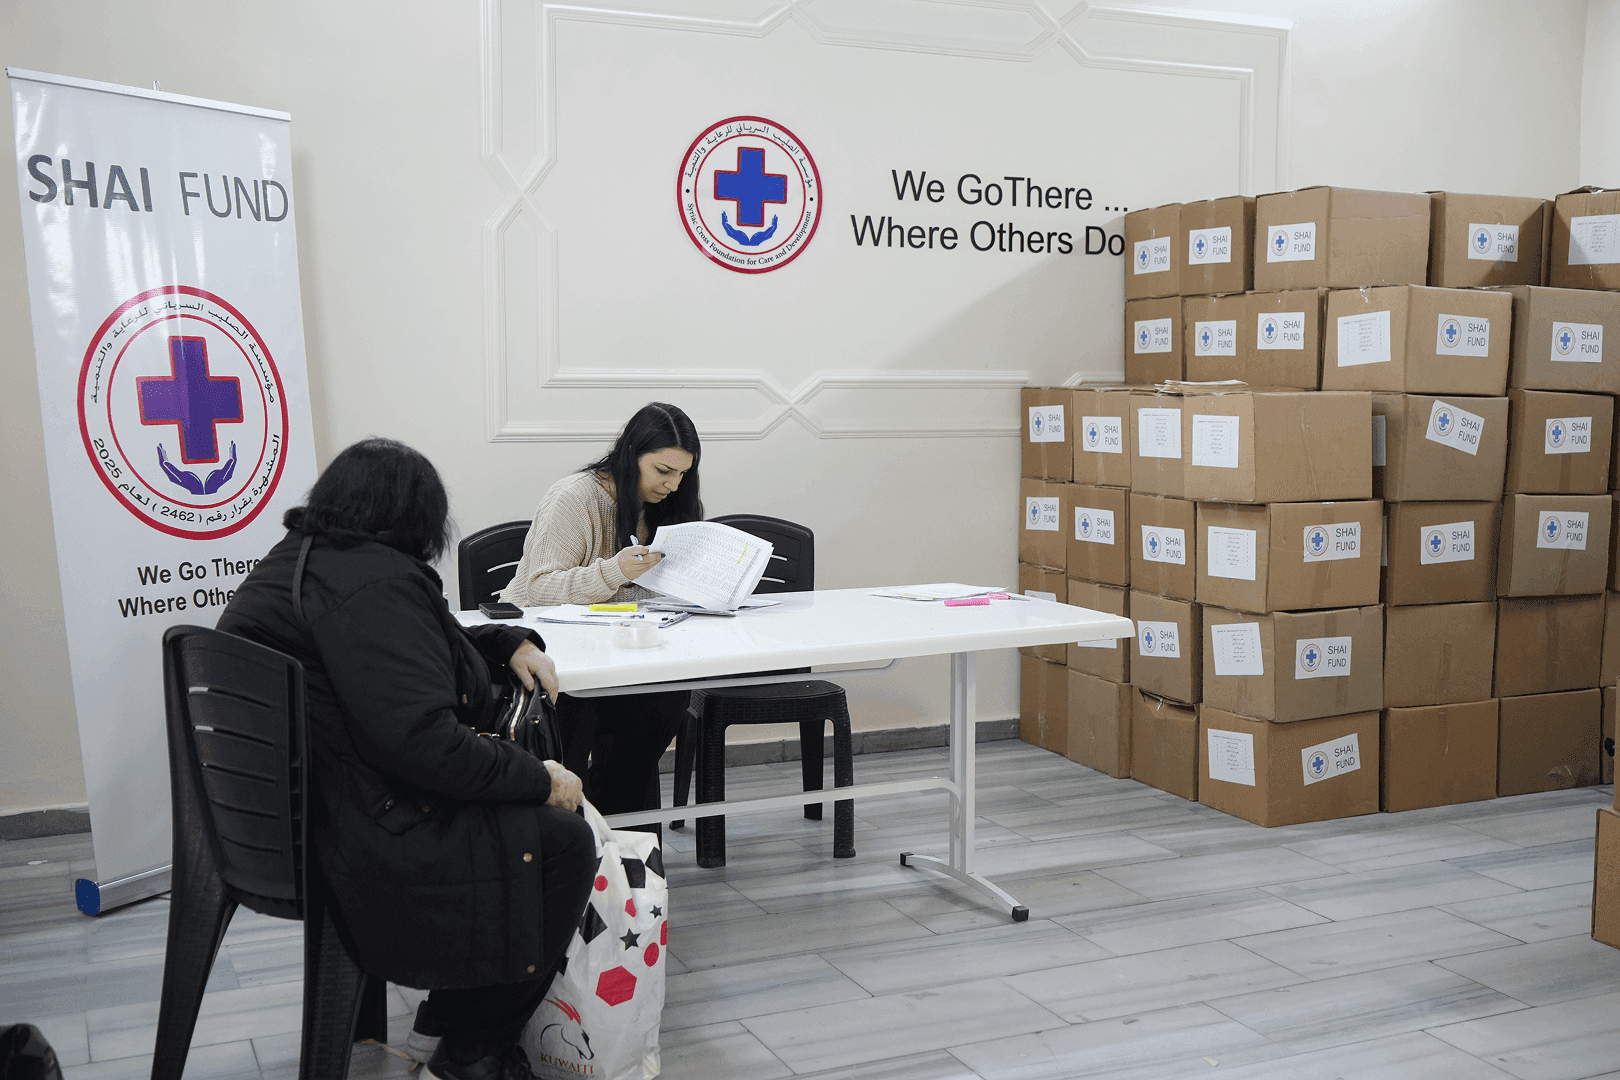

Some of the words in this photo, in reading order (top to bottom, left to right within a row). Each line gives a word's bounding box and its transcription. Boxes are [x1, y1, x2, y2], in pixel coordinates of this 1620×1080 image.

[736, 123, 769, 135] السرياني
[706, 125, 732, 144] للرعاية
[773, 132, 799, 155] الصليب
[685, 146, 706, 177] والتنمية
[799, 157, 812, 188] مؤسسة
[27, 154, 152, 212] SHAI
[179, 172, 288, 222] FUND
[892, 170, 944, 202] We
[687, 203, 698, 226] Syriac
[696, 226, 709, 244] Cross
[710, 242, 745, 264] Foundation
[758, 257, 774, 265] Care
[775, 248, 786, 259] and
[786, 211, 811, 251] Development
[850, 215, 958, 249] Where
[970, 221, 1073, 254] Others
[1294, 231, 1311, 240] SHAI
[1498, 232, 1514, 241] SHAI
[1213, 235, 1227, 244] SHAI
[1154, 246, 1167, 254] SHAI
[1213, 247, 1227, 255] FUND
[1294, 243, 1311, 252] FUND
[1498, 244, 1514, 253] FUND
[1154, 256, 1167, 264] FUND
[154, 300, 204, 316] السرياني
[112, 307, 148, 338] للرعاية
[208, 310, 248, 340] الصليب
[1283, 321, 1300, 329] SHAI
[1155, 327, 1168, 335] SHAI
[1468, 323, 1486, 333] SHAI
[1284, 333, 1300, 341] FUND
[1582, 331, 1599, 340] SHAI
[1218, 340, 1232, 348] FUND
[1467, 337, 1485, 346] FUND
[1581, 344, 1599, 353] FUND
[90, 342, 112, 403] والتنمية
[248, 342, 274, 403] مؤسسة
[1048, 414, 1060, 422] SHAI
[1049, 425, 1061, 433] FUND
[1104, 425, 1118, 433] SHAI
[1461, 418, 1480, 431] SHAI
[1572, 423, 1587, 431] SHAI
[1105, 437, 1118, 445] FUND
[1458, 431, 1477, 444] FUND
[1572, 435, 1587, 444] FUND
[93, 438, 122, 479] 2025
[252, 434, 279, 497] المشهرة
[118, 482, 150, 506] لعام
[230, 495, 253, 519] بقرار
[206, 510, 227, 525] رقم
[1044, 515, 1056, 523] FUND
[1097, 518, 1110, 526] SHAI
[1567, 520, 1584, 528] SHAI
[1097, 529, 1110, 538] FUND
[1336, 528, 1356, 537] SHAI
[1452, 531, 1469, 540] SHAI
[1566, 532, 1583, 541] FUND
[1166, 537, 1180, 546] SHAI
[1336, 541, 1356, 551] FUND
[1453, 543, 1470, 552] FUND
[1166, 549, 1181, 558] FUND
[138, 565, 171, 585] We
[179, 562, 206, 580] Go
[118, 596, 186, 618] Where
[1160, 631, 1174, 639] SHAI
[1161, 643, 1175, 652] FUND
[1328, 646, 1346, 654] SHAI
[1328, 658, 1346, 667] FUND
[1335, 744, 1353, 757] SHAI
[1336, 757, 1355, 769] FUND
[541, 1054, 593, 1074] KUWAITI
